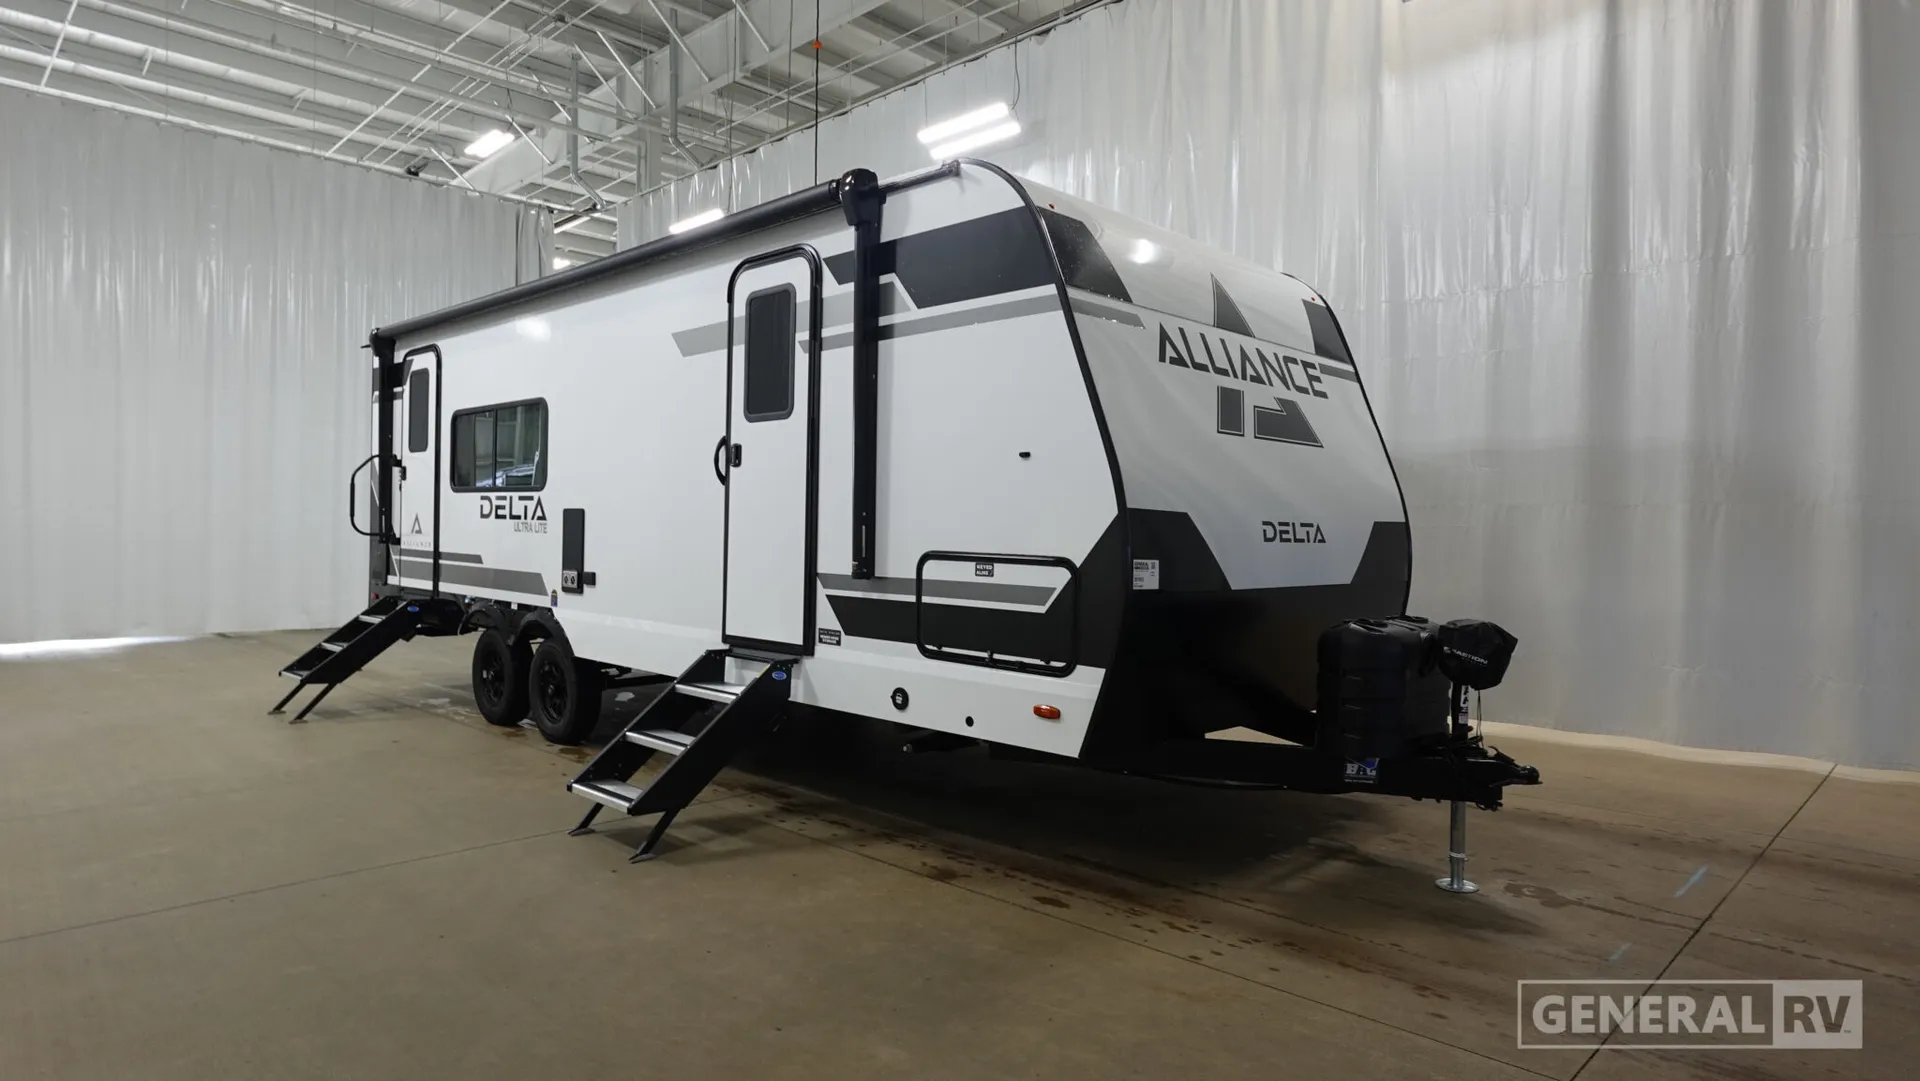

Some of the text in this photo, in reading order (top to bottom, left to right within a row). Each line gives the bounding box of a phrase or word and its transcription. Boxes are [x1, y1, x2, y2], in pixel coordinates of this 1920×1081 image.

[1158, 321, 1329, 399] ALLIANCE
[480, 495, 548, 521] DELTA
[513, 521, 548, 534] ULTRA LITE
[1261, 521, 1327, 544] DELTA
